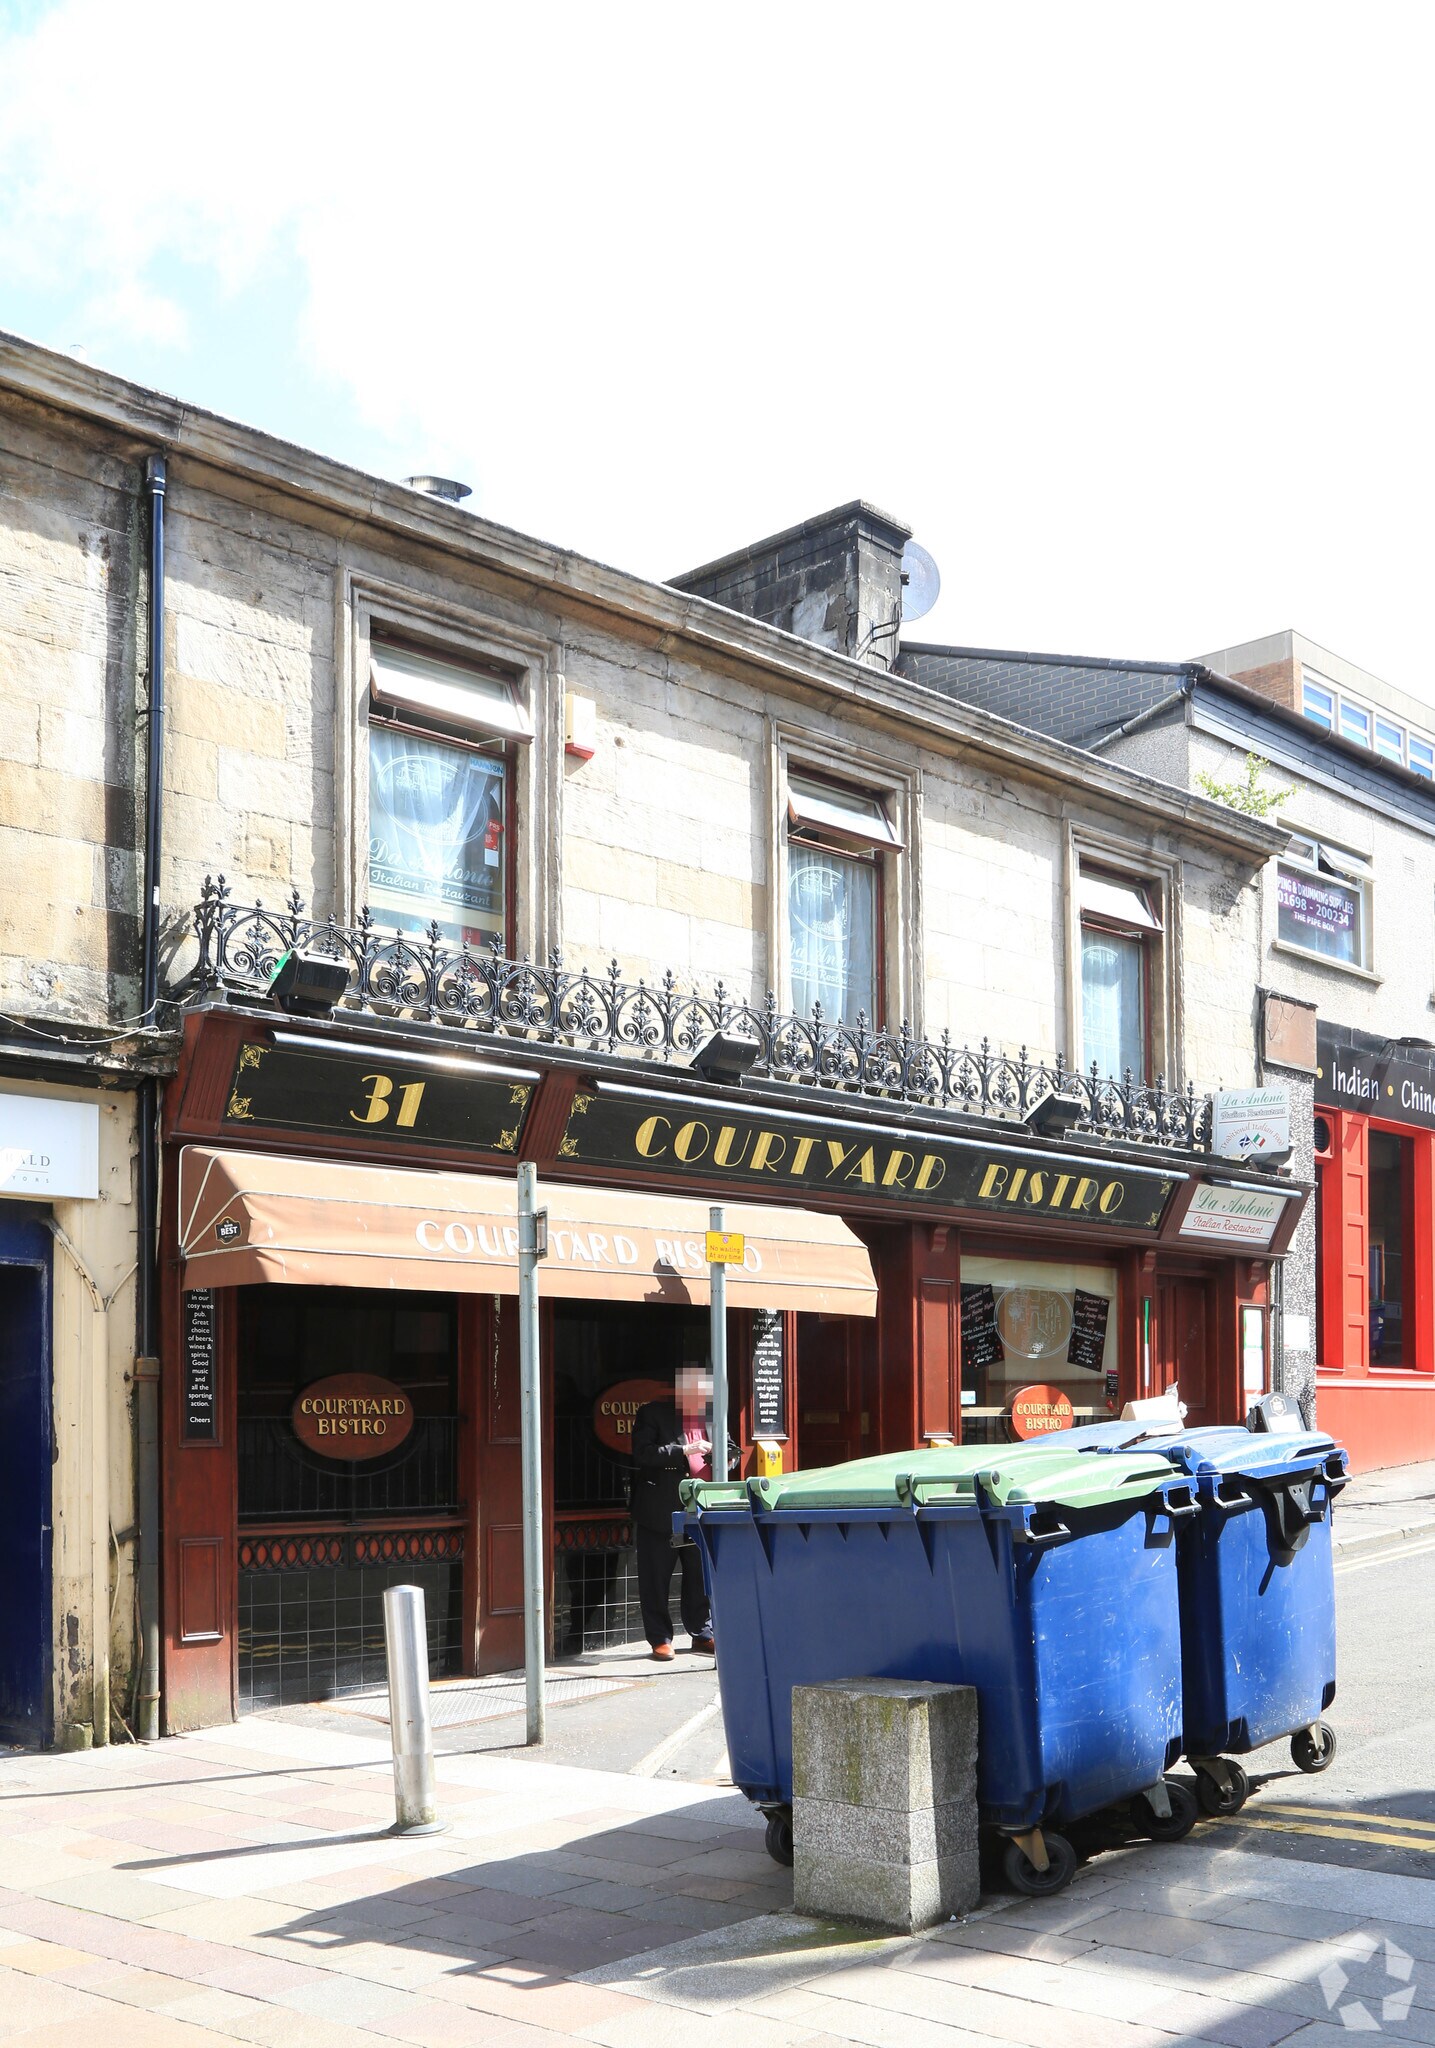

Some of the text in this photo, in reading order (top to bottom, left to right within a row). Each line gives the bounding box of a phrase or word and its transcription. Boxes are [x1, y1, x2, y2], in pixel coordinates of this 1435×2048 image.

[370, 869, 420, 891] Italian
[1278, 889, 1307, 911] 01698
[1316, 903, 1350, 926] 200234
[1297, 882, 1329, 906] DRUMMING
[1329, 895, 1354, 915] SUPPLIES
[1294, 911, 1335, 933] THE PIPE BOX
[1332, 1062, 1379, 1101] Indian
[350, 1074, 426, 1128] 31
[1241, 1091, 1286, 1105] Antonio
[1221, 1107, 1286, 1120] Italian Restaurant
[1220, 1122, 1251, 1150] Traditional
[1252, 1122, 1275, 1136] Italian
[635, 1116, 1125, 1214] COURTYARD BISTRO
[1196, 1188, 1275, 1218] Da Antonio
[220, 1226, 238, 1236] BEST
[1193, 1215, 1264, 1235] Italian Restaurant
[415, 1220, 638, 1265] COURYARD
[192, 1318, 209, 1326] Great
[758, 1357, 778, 1367] Great
[188, 1392, 213, 1400] sporting
[301, 1398, 406, 1415] COURTYARD
[1016, 1403, 1071, 1416] COURTYARD
[318, 1418, 387, 1435] BISTRO
[1026, 1417, 1062, 1431] BISTRO
